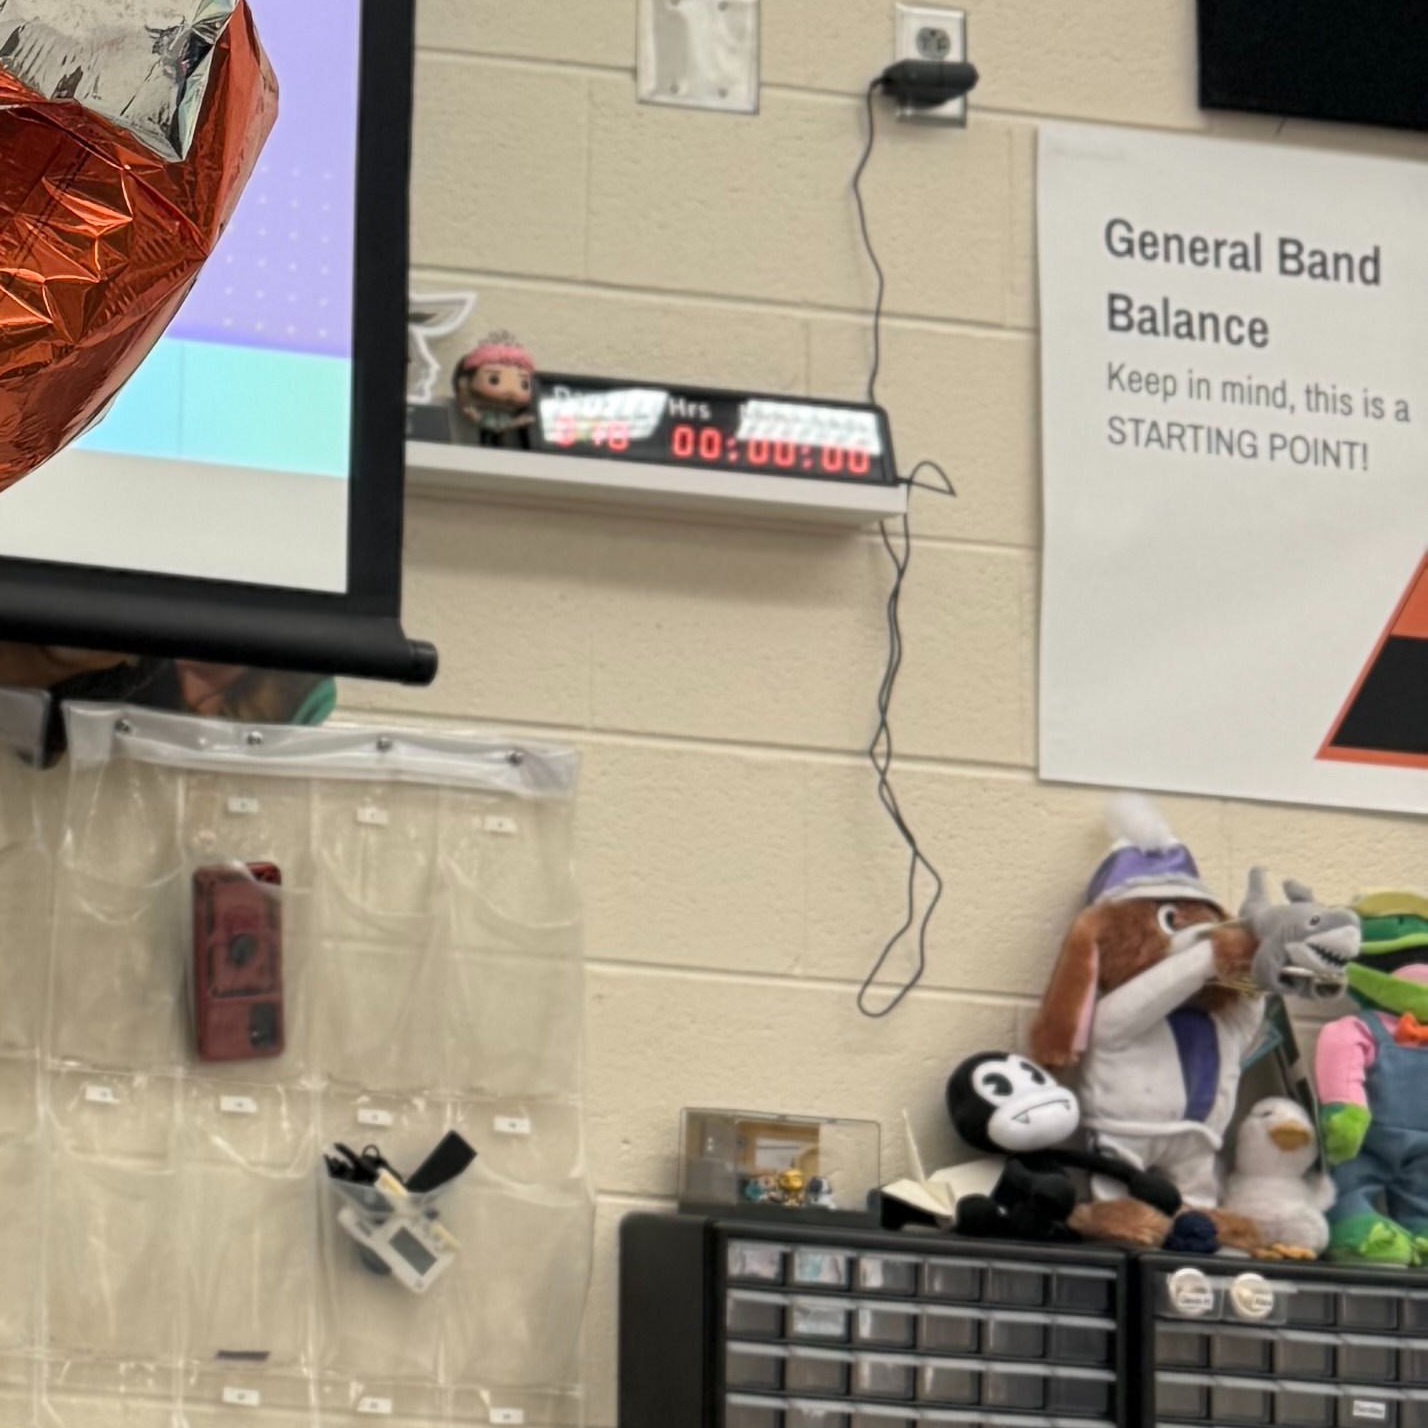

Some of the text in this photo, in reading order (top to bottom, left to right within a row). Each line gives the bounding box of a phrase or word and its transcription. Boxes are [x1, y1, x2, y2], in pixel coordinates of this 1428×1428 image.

[1105, 219, 1382, 286] General Band
[1107, 292, 1270, 349] Balance
[669, 397, 711, 420] Hrs
[1107, 362, 1411, 423] Keep in mind, this is a
[1107, 417, 1370, 472] STARTING POINT!
